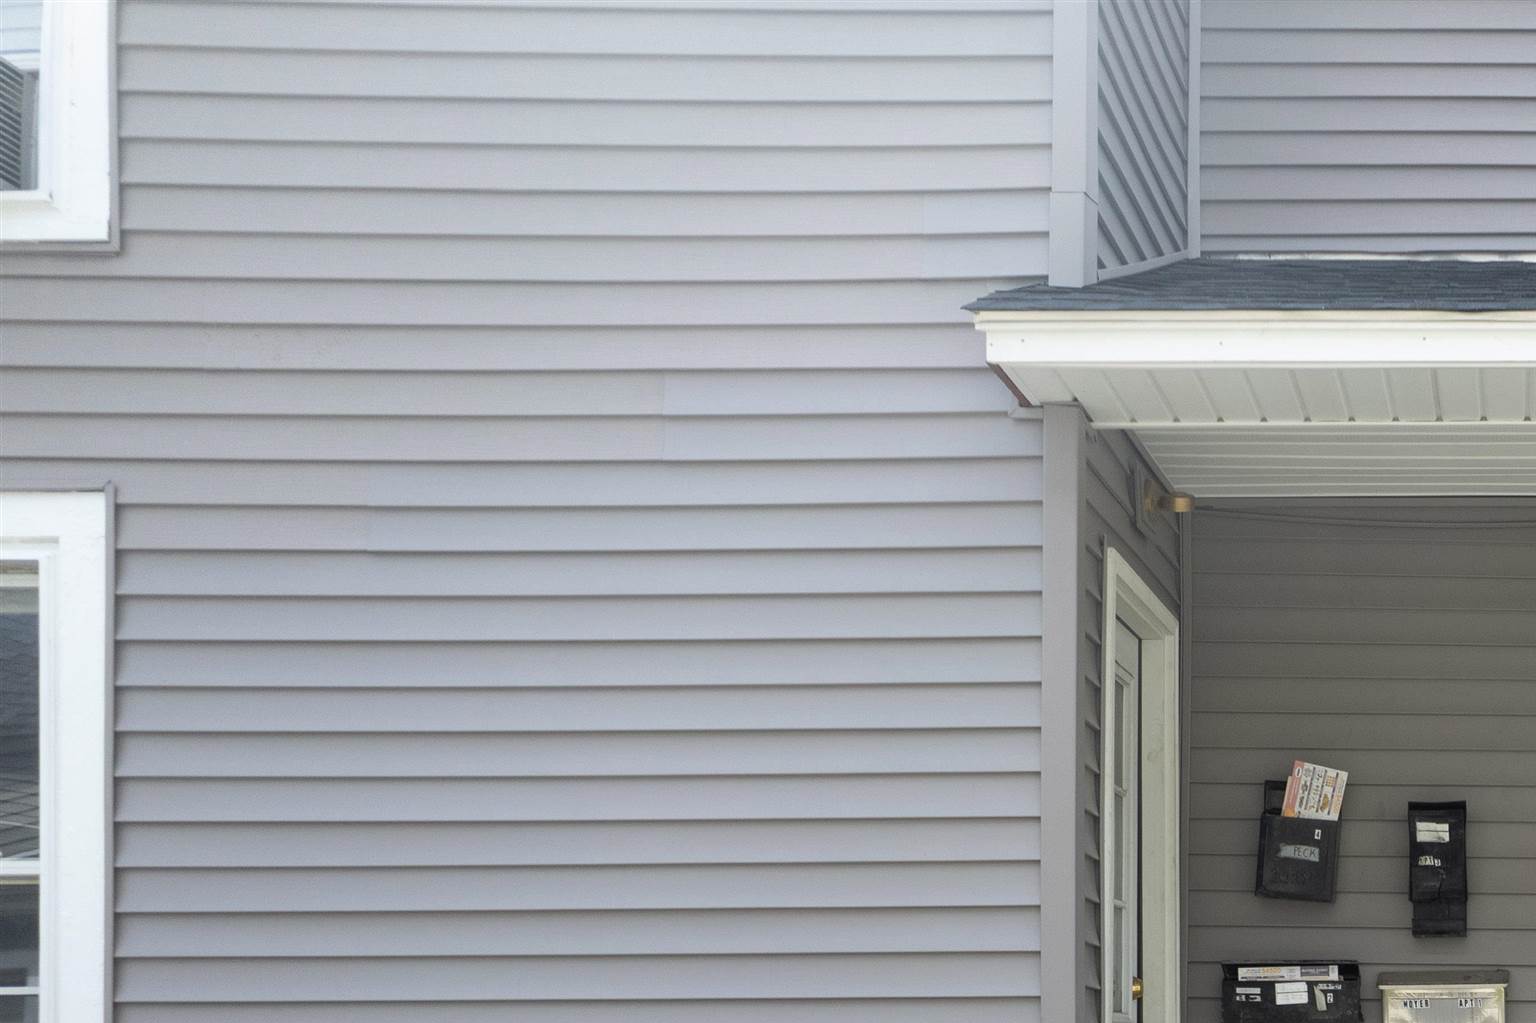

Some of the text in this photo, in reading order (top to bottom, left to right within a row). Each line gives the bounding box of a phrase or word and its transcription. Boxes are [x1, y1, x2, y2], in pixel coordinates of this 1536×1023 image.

[1293, 847, 1317, 858] PECK
[1327, 993, 1333, 1003] 2
[1403, 1000, 1429, 1008] MOYER
[1459, 1000, 1474, 1008] APT
